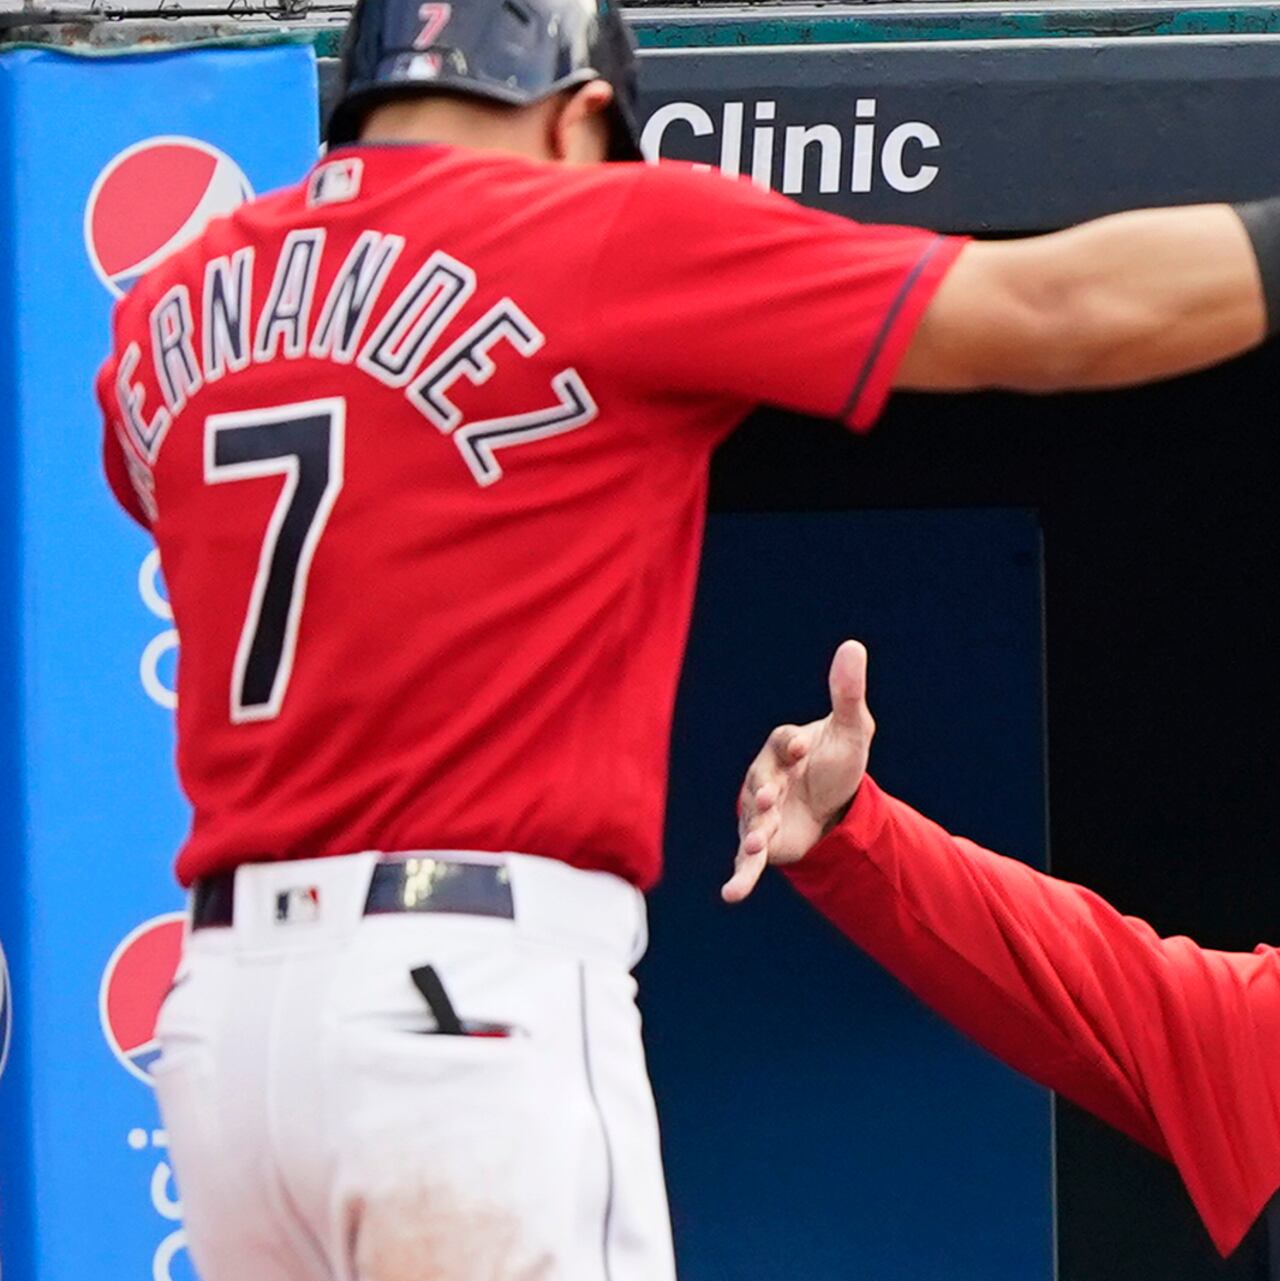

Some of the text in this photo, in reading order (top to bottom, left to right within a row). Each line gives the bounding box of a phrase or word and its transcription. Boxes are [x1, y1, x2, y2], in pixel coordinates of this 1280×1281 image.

[412, 2, 452, 51] 7
[640, 99, 941, 194] Clinic
[112, 227, 599, 523] ERNANDEZ
[203, 396, 346, 724] 7
